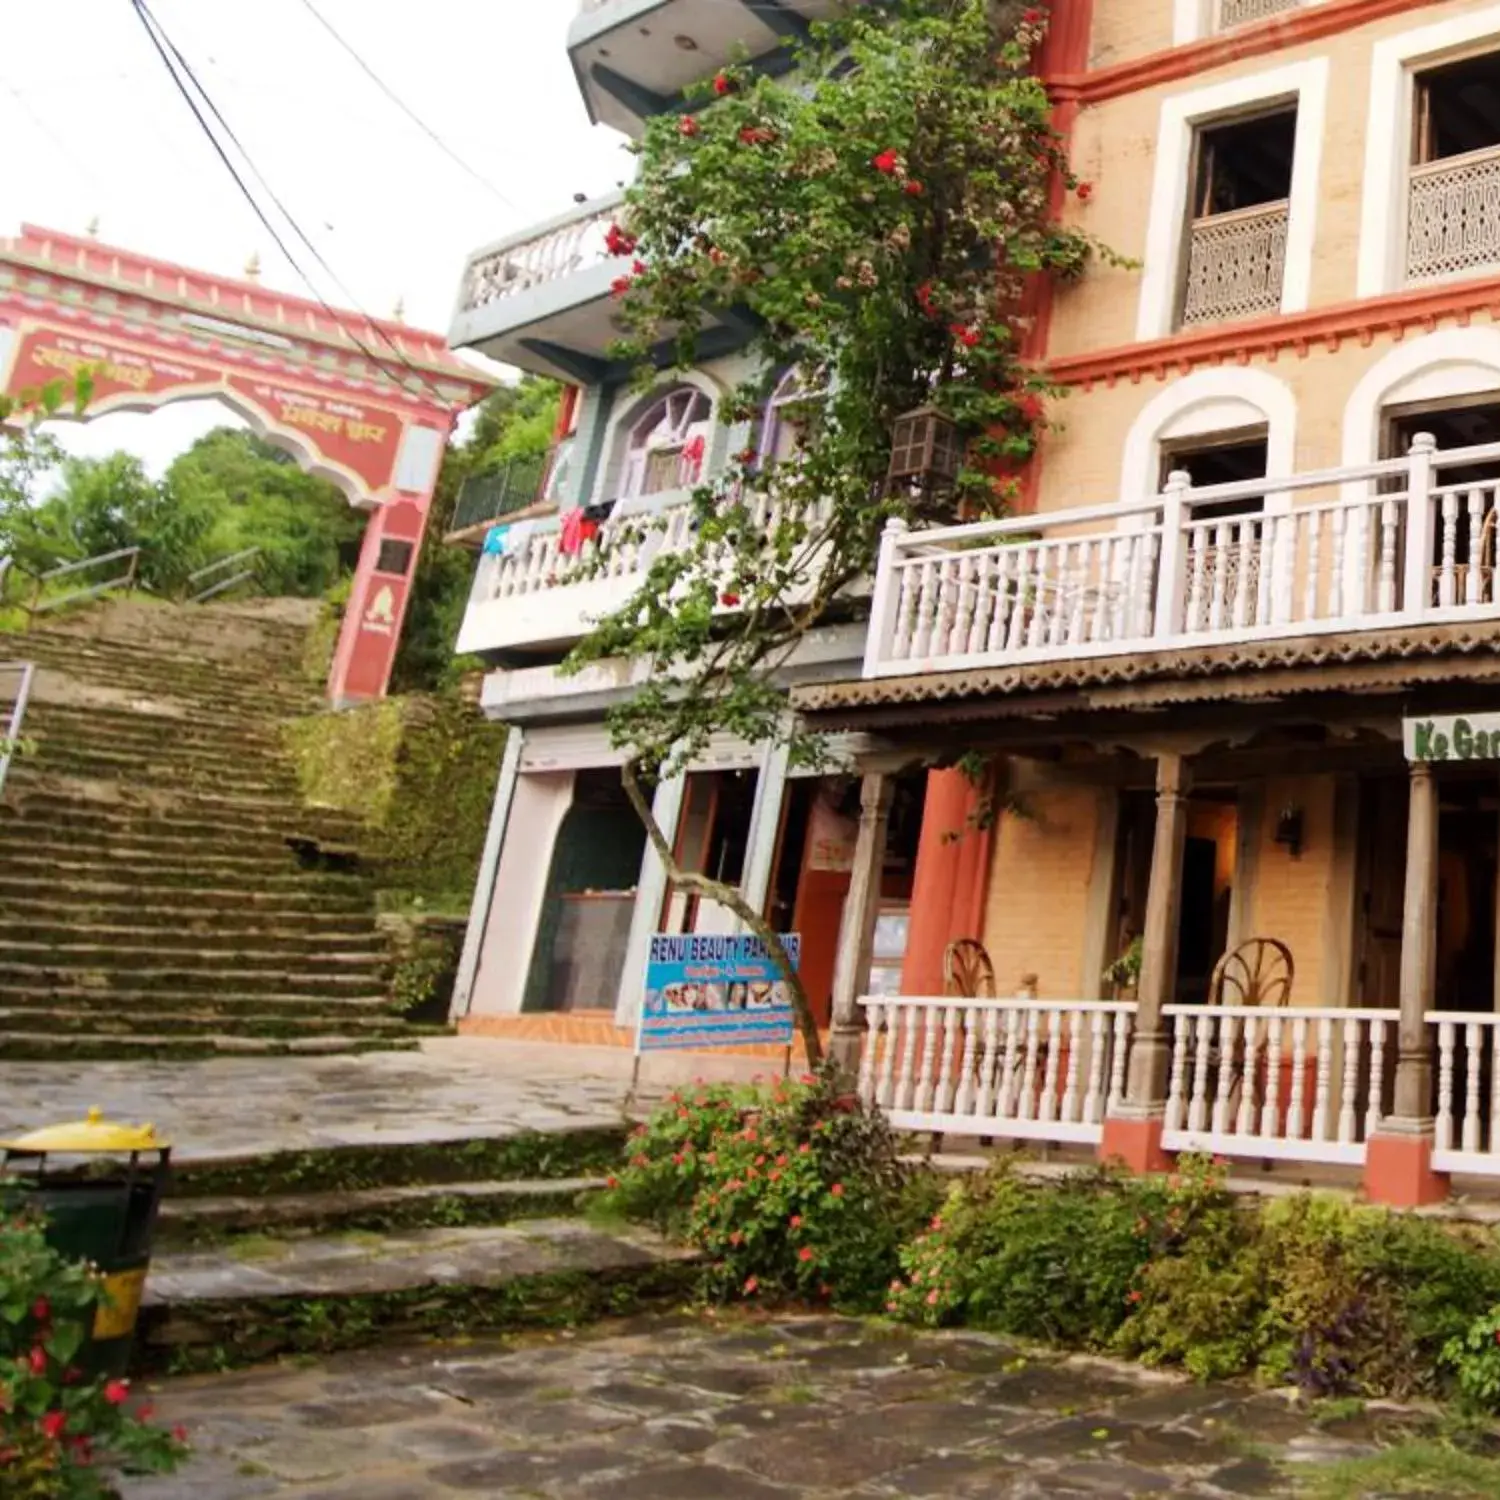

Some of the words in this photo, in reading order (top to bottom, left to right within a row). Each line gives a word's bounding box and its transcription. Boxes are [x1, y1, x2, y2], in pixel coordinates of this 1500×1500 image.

[1415, 720, 1449, 759] Ke
[650, 936, 686, 962] RENU
[690, 936, 739, 961] BEAUTY
